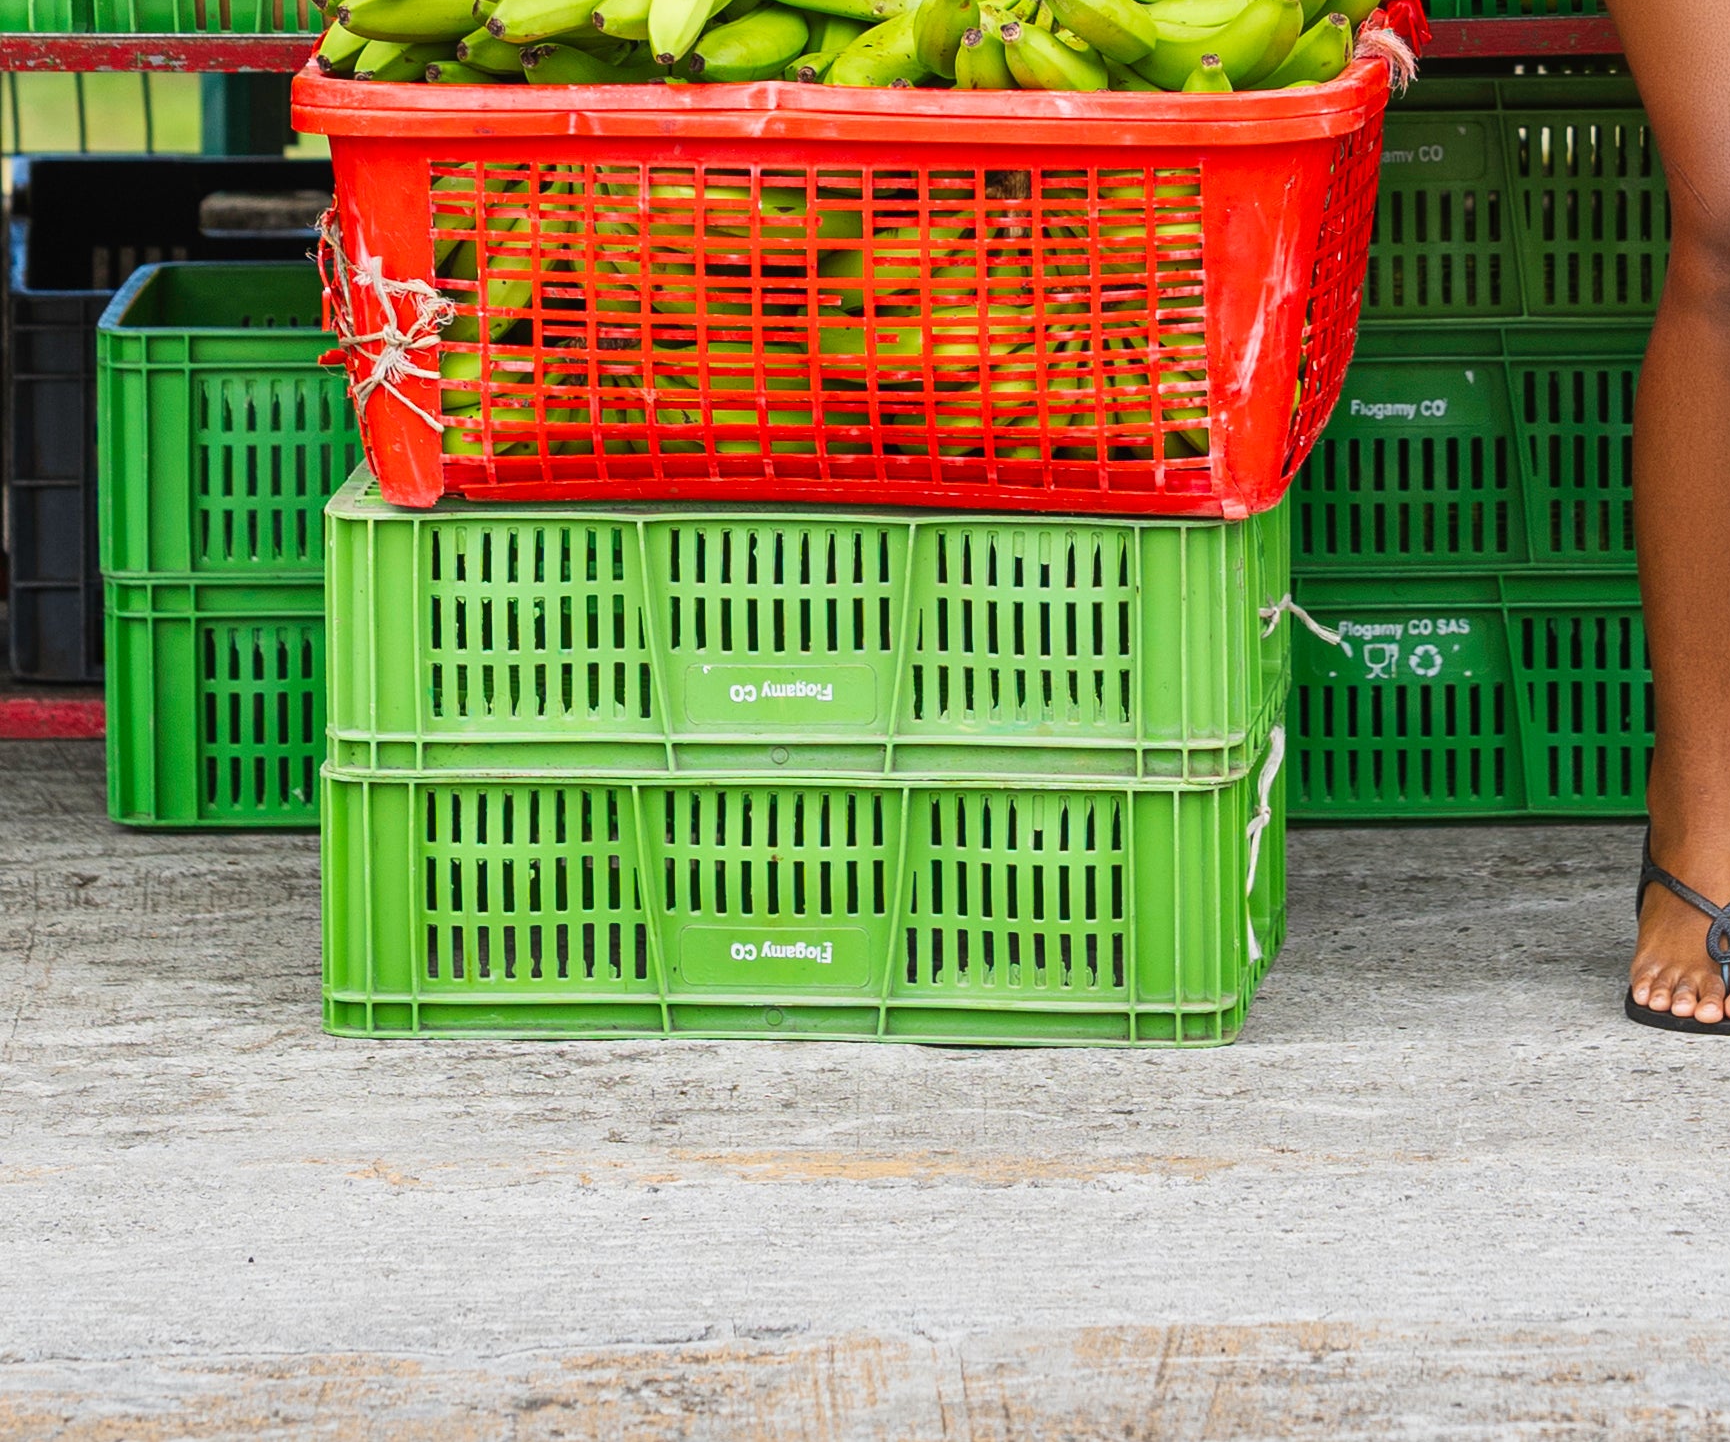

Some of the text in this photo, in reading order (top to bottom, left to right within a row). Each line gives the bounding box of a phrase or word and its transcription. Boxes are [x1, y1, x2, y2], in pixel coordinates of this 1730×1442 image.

[1418, 145, 1444, 162] CO
[1420, 399, 1446, 417] CO
[1338, 619, 1471, 641] Flogamy CO SAS
[729, 679, 833, 703] Flogamy CO
[730, 940, 833, 964] Flogamy CO
